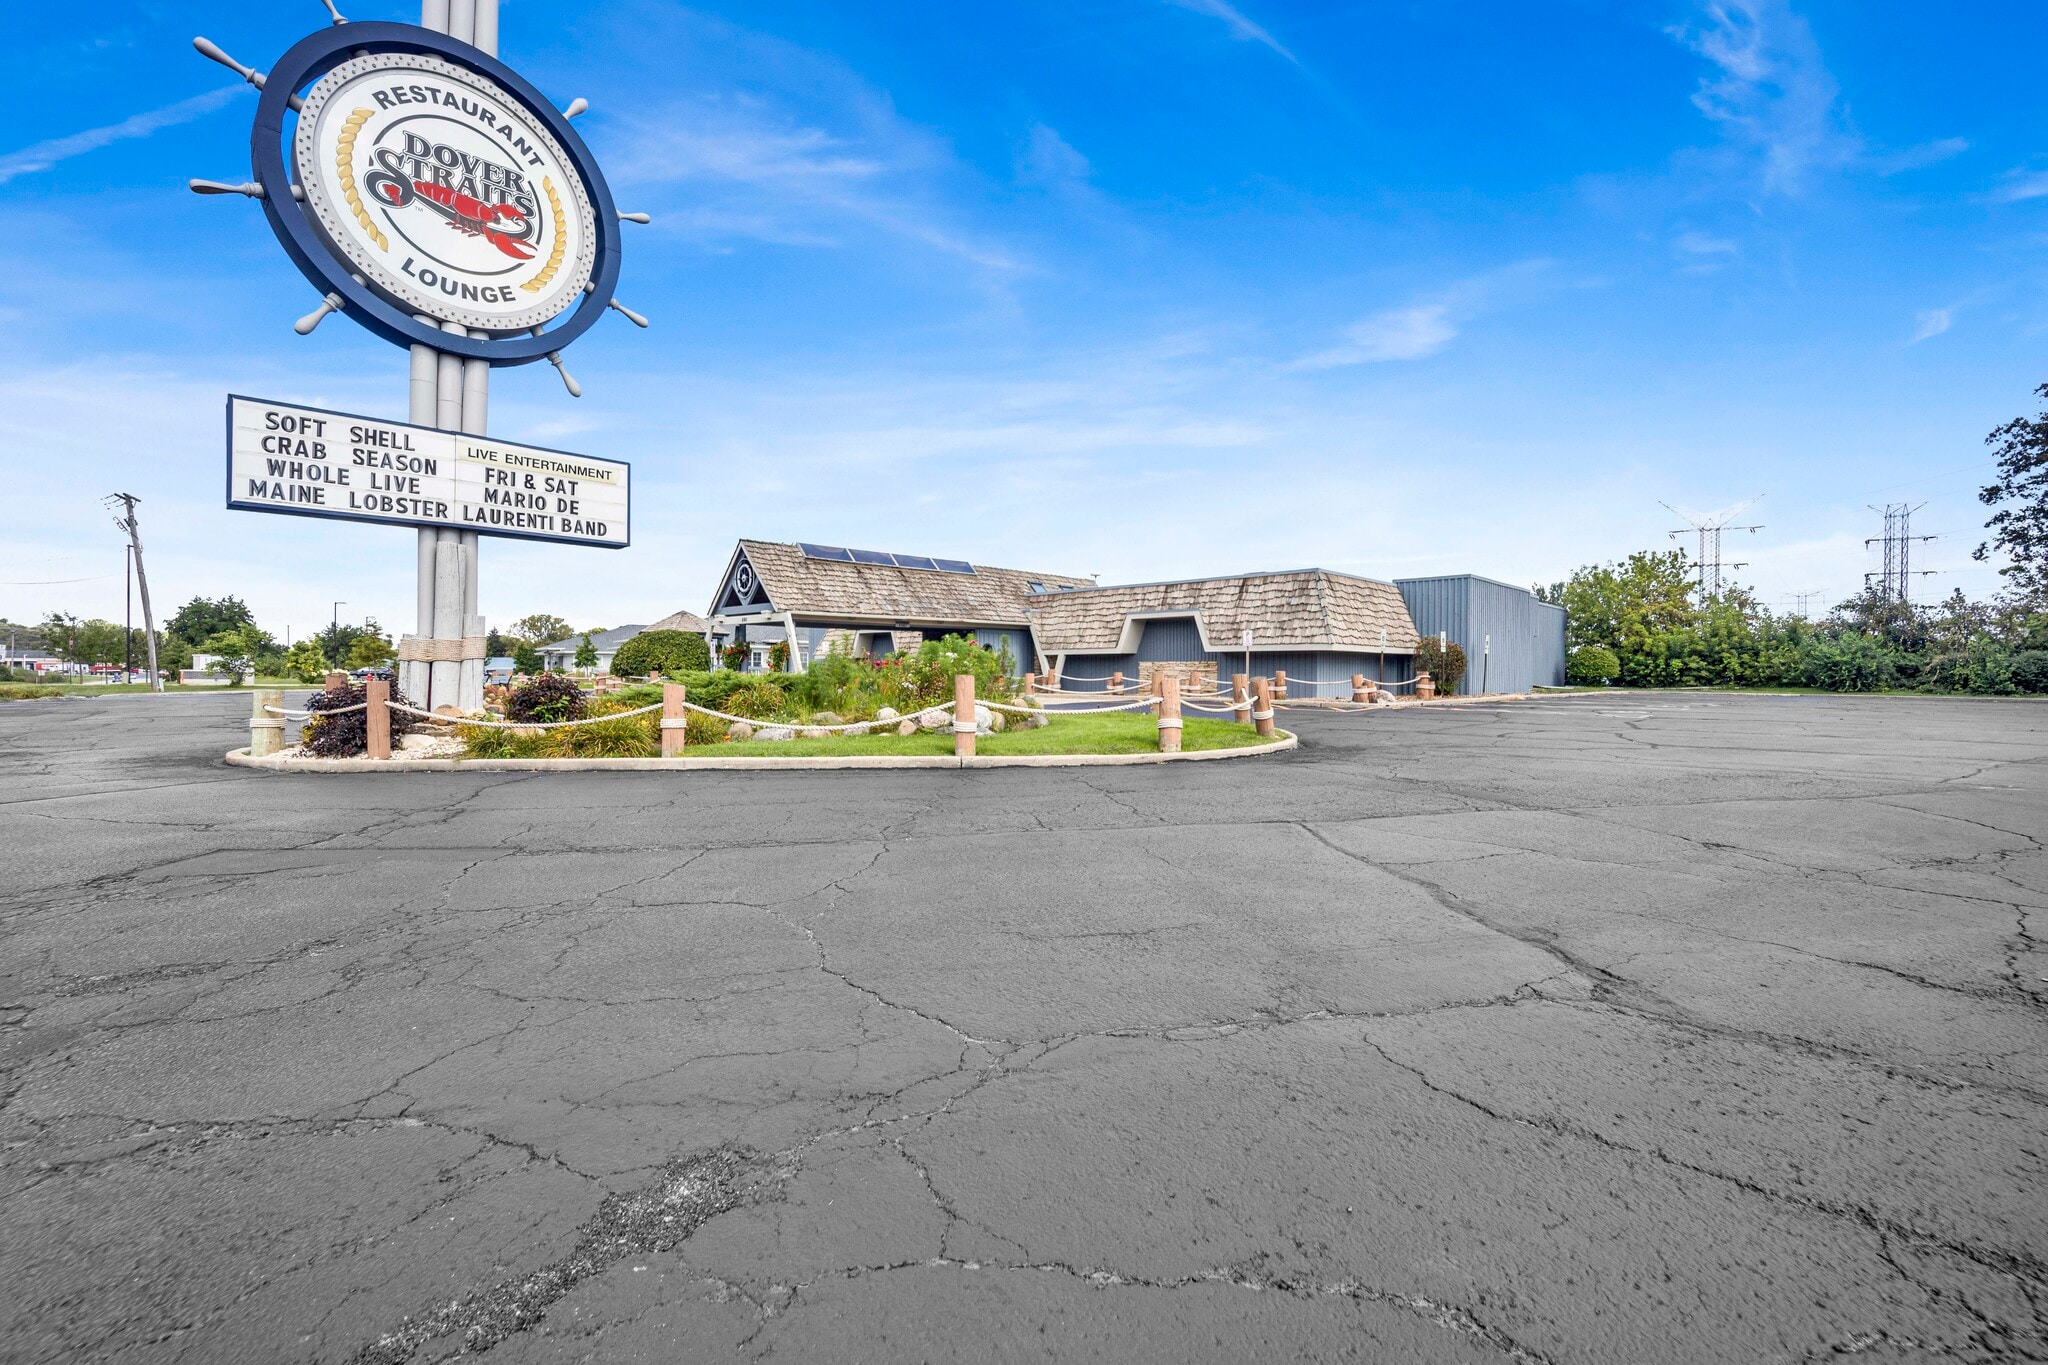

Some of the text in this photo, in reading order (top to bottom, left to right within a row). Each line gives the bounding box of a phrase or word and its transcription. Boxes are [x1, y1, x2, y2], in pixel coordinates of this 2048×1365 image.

[371, 85, 546, 169] RESTAURANT
[402, 130, 530, 196] DOVER
[364, 147, 537, 241] STRAITS
[400, 257, 516, 304] LOUNGE
[265, 411, 415, 451] SOFT SHELL
[261, 435, 437, 475] CRAB SEASON
[468, 447, 612, 480] LIVE ENTERTAINMENT
[266, 458, 420, 494] WHOLE LIVE
[485, 467, 579, 496] FRI & SAT
[249, 478, 448, 519] MAINE LOBSTER
[484, 487, 579, 515] MARIO DE
[463, 505, 607, 537] LAURENTI BAND
